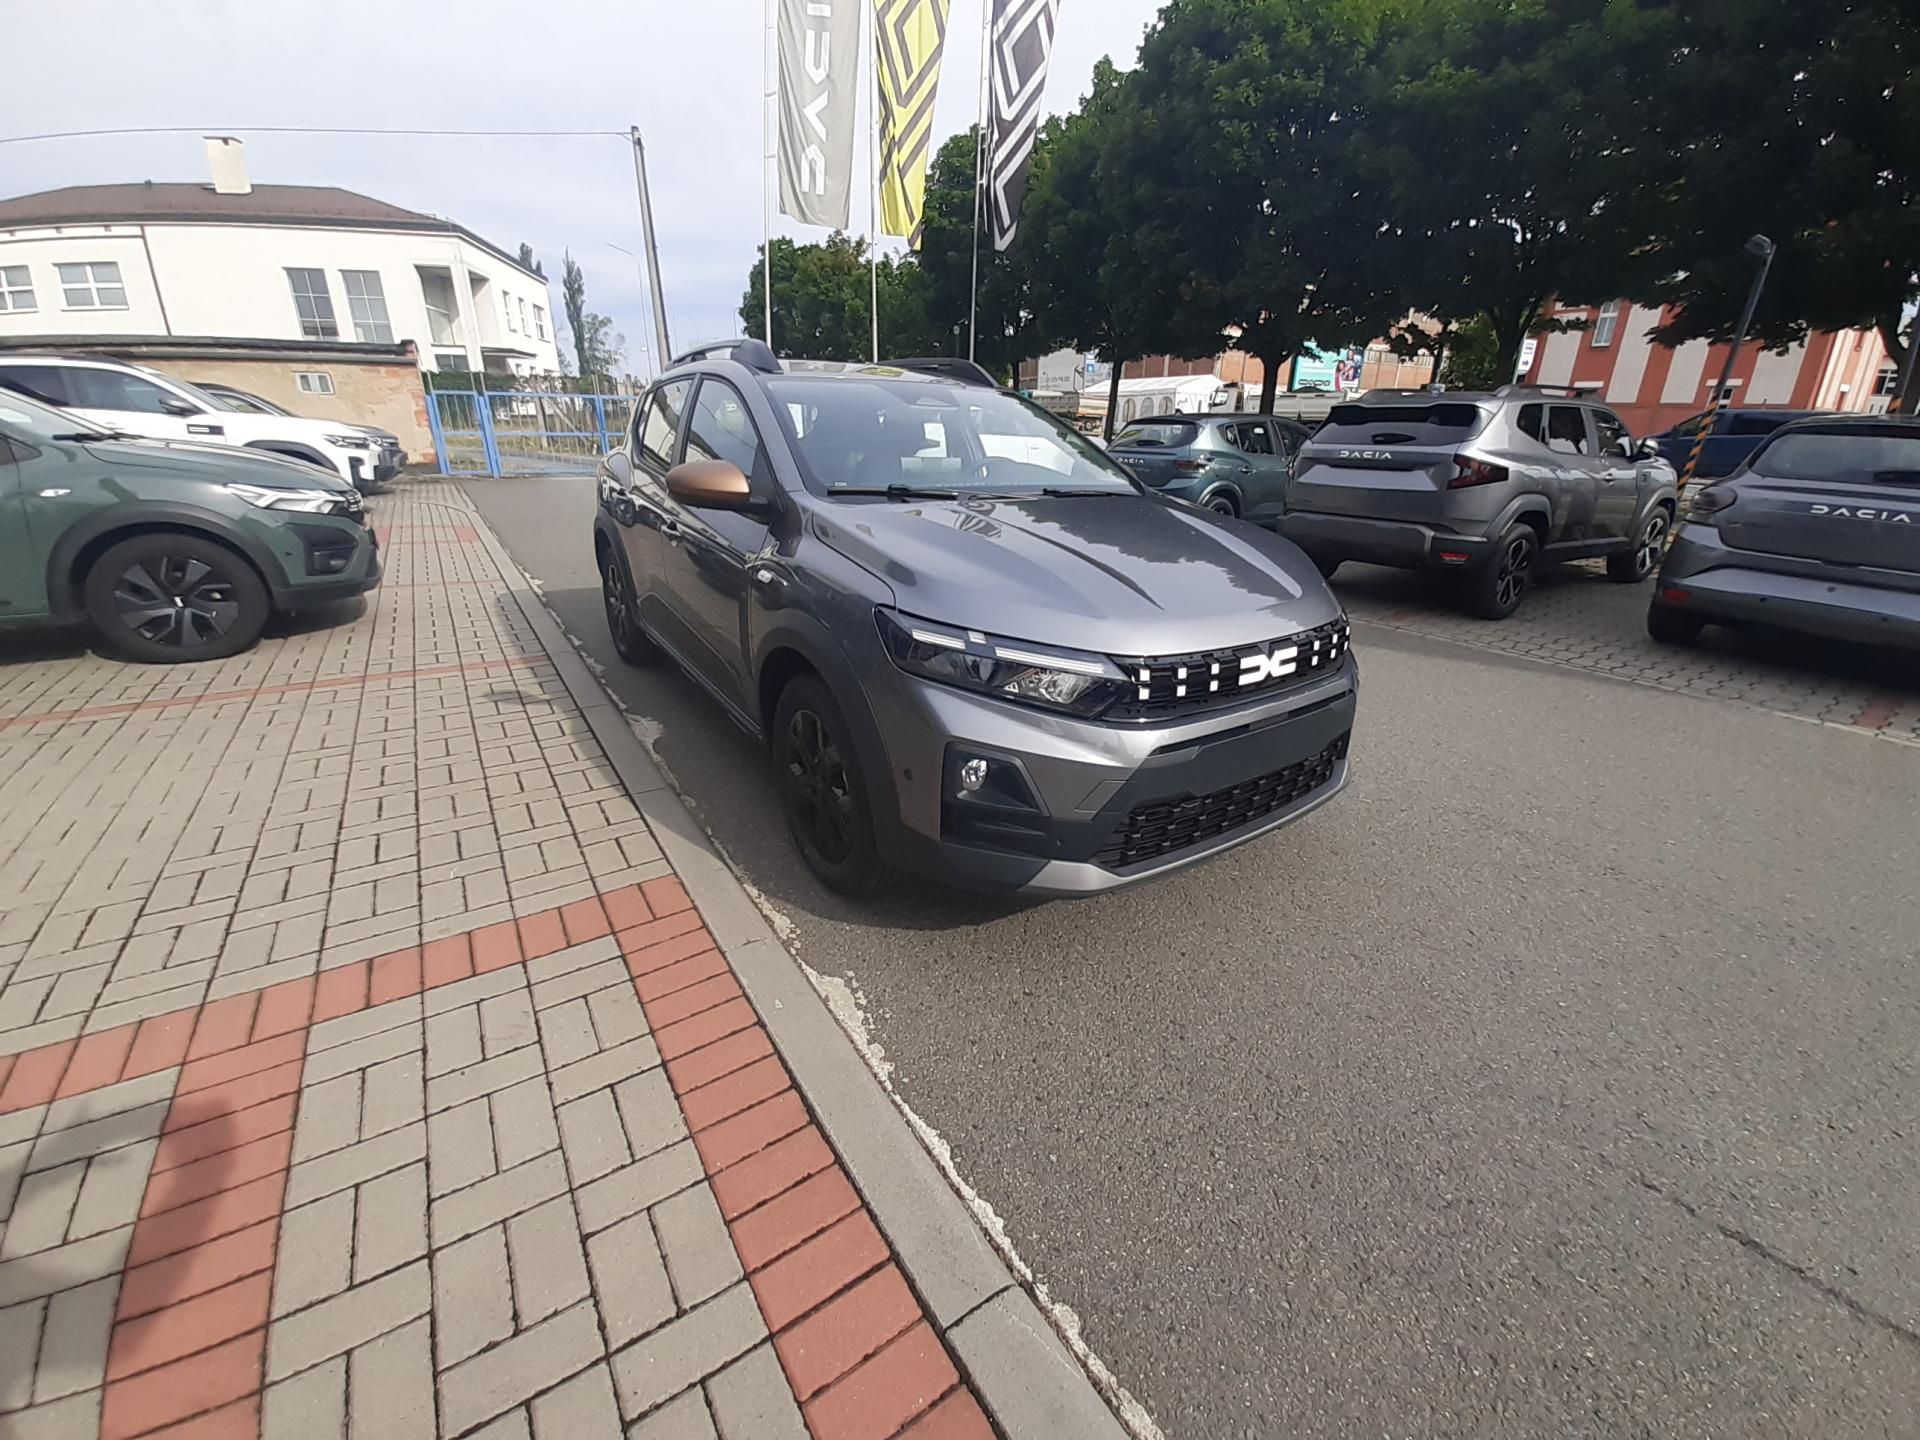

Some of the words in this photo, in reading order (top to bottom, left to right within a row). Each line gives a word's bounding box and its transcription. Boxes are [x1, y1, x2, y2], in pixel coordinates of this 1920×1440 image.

[801, 2, 832, 195] DACI
[1339, 450, 1392, 459] DACIA
[1810, 505, 1912, 523] DACIA
